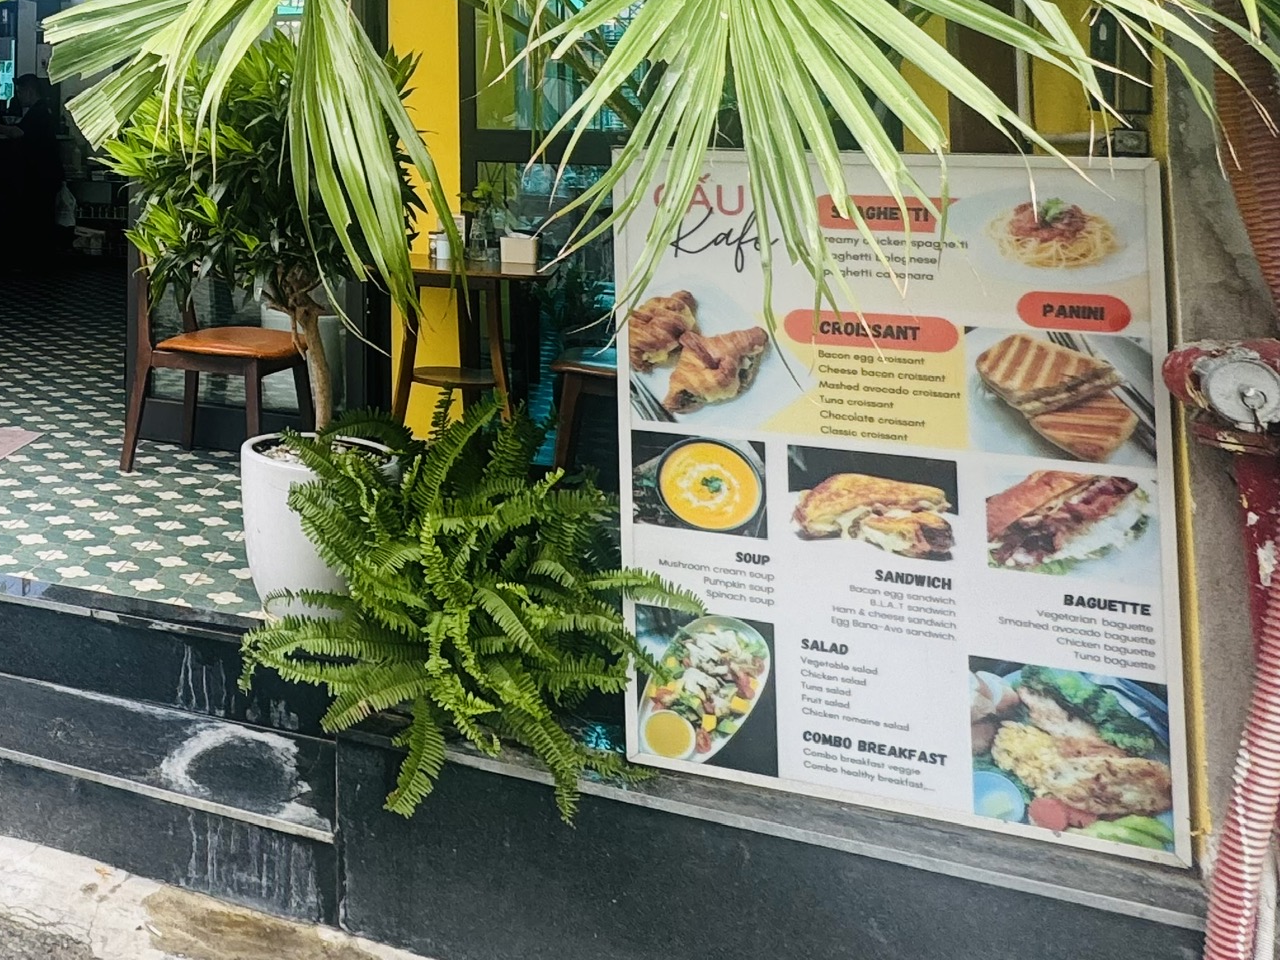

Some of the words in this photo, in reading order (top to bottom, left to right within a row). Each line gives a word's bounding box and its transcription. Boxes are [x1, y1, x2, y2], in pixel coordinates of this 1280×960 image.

[822, 236, 860, 247] reamy
[1042, 303, 1105, 321] PANINI
[819, 320, 921, 341] CROISSANT
[818, 349, 851, 360] Bacon
[853, 354, 874, 364] egg
[877, 355, 925, 365] croissant
[818, 364, 858, 375] Cheese
[861, 367, 894, 379] bacon
[897, 371, 946, 383] croissant
[818, 380, 859, 391] Mashed
[862, 386, 910, 395] avocado
[912, 389, 961, 399] croissant
[819, 395, 844, 405] Tuna
[846, 397, 894, 409] croissant
[819, 410, 875, 423] Chocolate
[877, 417, 925, 428] croissant
[820, 425, 857, 437] Classic
[861, 430, 908, 441] croissant
[735, 551, 770, 565] SOUP
[658, 558, 710, 572] Mushroom
[713, 566, 747, 577] cream
[749, 571, 775, 582] soup
[703, 576, 746, 589] Pumpkin
[749, 583, 775, 594] soup
[874, 569, 952, 591] SANDWICH
[705, 589, 747, 601] Spinach
[749, 595, 775, 607] soup
[849, 584, 881, 595] Bacon
[883, 590, 904, 600] egg
[907, 604, 956, 617] sandwich
[1063, 594, 1152, 616] BAGUETTE
[831, 616, 850, 628] Egg
[832, 605, 856, 615] Ham
[858, 608, 866, 616] &
[868, 610, 905, 622] cheese
[907, 616, 957, 630] sandwich
[1036, 609, 1097, 625] Vegetarian
[1101, 617, 1154, 633] baguette
[998, 616, 1049, 631] Smashed
[1051, 624, 1101, 638] avocado
[1104, 631, 1156, 646] baguette
[800, 638, 849, 655] SALAD
[1056, 636, 1100, 650] Chicken
[1104, 642, 1156, 658] baguette
[800, 656, 850, 671] Vegetable
[852, 665, 878, 675] salad
[1074, 651, 1100, 662] Tuna
[1103, 655, 1156, 671] baguette
[800, 668, 838, 682] Chicken
[840, 676, 867, 686] salad
[800, 681, 823, 692] Tuna
[825, 686, 852, 697] salad
[801, 694, 822, 704] Fruit
[824, 698, 850, 709] salad
[801, 707, 840, 720] Chicken
[842, 714, 881, 727] romaine
[883, 720, 910, 732] salad
[802, 730, 852, 750] COMBO
[857, 740, 948, 767] BREAKFAST
[803, 747, 838, 761] Combo
[840, 753, 885, 769] breakfast
[888, 764, 921, 776] veggie
[803, 760, 838, 774] Combo
[840, 767, 875, 782] healthy
